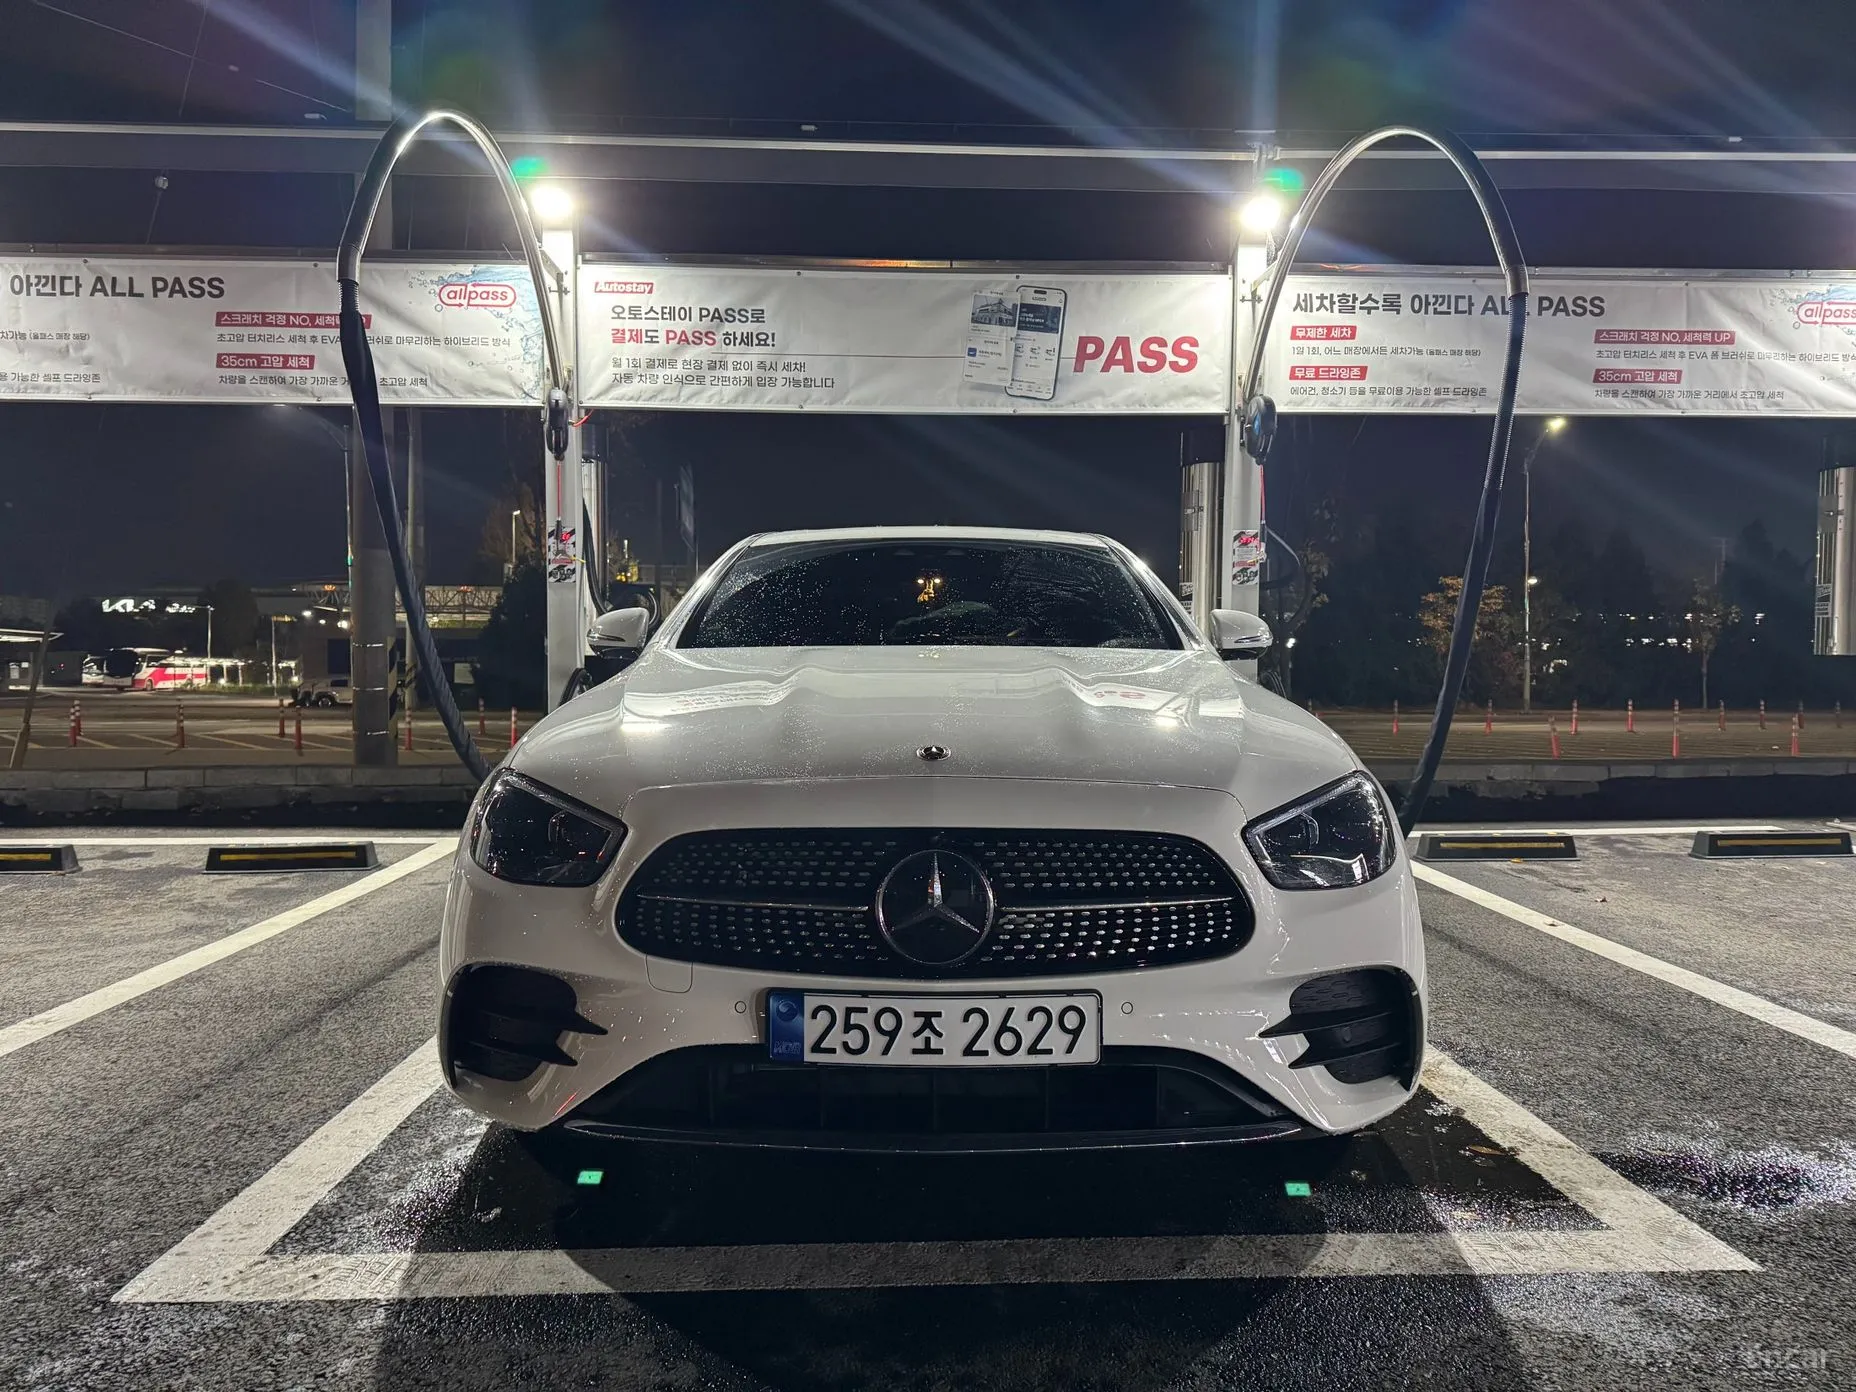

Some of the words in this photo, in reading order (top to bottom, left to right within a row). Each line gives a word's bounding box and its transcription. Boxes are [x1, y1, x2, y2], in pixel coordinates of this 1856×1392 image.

[10, 275, 82, 297] 아낀다
[90, 277, 144, 298] ALL
[152, 277, 225, 298] PASS
[595, 282, 652, 294] Autostay
[446, 284, 509, 307] allpass
[1293, 293, 1401, 315] 세차할수록
[1410, 294, 1475, 315] 아낀다
[1480, 295, 1530, 316] AL
[1537, 295, 1605, 317] PASS
[220, 314, 262, 325] 스크래치
[265, 314, 287, 326] 걱정
[611, 305, 692, 322] 오토스테이
[698, 307, 766, 324] PASS로
[611, 328, 660, 344] 결제도
[665, 329, 717, 346] PASS
[722, 331, 776, 348] 하세요!
[1295, 327, 1328, 339] 무제한
[1330, 327, 1352, 339] 세차
[1599, 332, 1638, 342] 스크래치
[1640, 332, 1660, 342] 걱정
[1683, 333, 1712, 343] 세척력
[1714, 333, 1731, 343] UP
[247, 334, 285, 344] 터치리스
[288, 334, 307, 344] 세척
[309, 335, 319, 345] 후
[321, 335, 341, 345] EVA
[366, 335, 394, 345] 러쉬로
[396, 336, 442, 346] 마무리하는
[444, 336, 490, 347] 하이브리드
[492, 337, 511, 347] 방식
[1072, 336, 1200, 374] PASS
[1324, 346, 1342, 355] 어느
[1623, 350, 1657, 360] 터치리스
[1660, 350, 1676, 360] 세척
[1688, 351, 1708, 360] EVA
[1721, 351, 1755, 361] 브러쉬로
[1798, 352, 1840, 362] 하이브리드
[220, 355, 257, 368] 35cm
[260, 356, 284, 368] 고압
[287, 356, 310, 369] 세척
[645, 357, 678, 370] 결제로
[681, 359, 704, 371] 현장
[706, 359, 729, 371] 결제
[731, 360, 753, 372] 없이
[756, 361, 778, 372] 즉시
[781, 361, 806, 373] 세차!
[1294, 367, 1316, 379] 무료
[1318, 367, 1361, 379] 드라잉존
[1598, 370, 1632, 382] 35cm
[1634, 371, 1655, 382] 고압
[1657, 371, 1678, 382] 세척
[249, 375, 287, 386] 스캔하여
[289, 376, 308, 386] 가장
[310, 376, 339, 386] 가까운
[379, 377, 407, 387] 초고압
[409, 377, 428, 387] 세척
[612, 372, 634, 384] 자동
[637, 373, 659, 385] 차량
[662, 374, 707, 386] 인식으로
[709, 375, 753, 387] 간편하게
[756, 376, 778, 388] 입장
[781, 377, 835, 389] 가능합니다
[1321, 386, 1347, 396] 청소기
[1621, 389, 1656, 399] 스캔하여
[1658, 390, 1675, 399] 가장
[1703, 390, 1738, 399] 거리에서
[810, 1003, 945, 1057] 259조
[962, 1004, 1087, 1057] 2629
